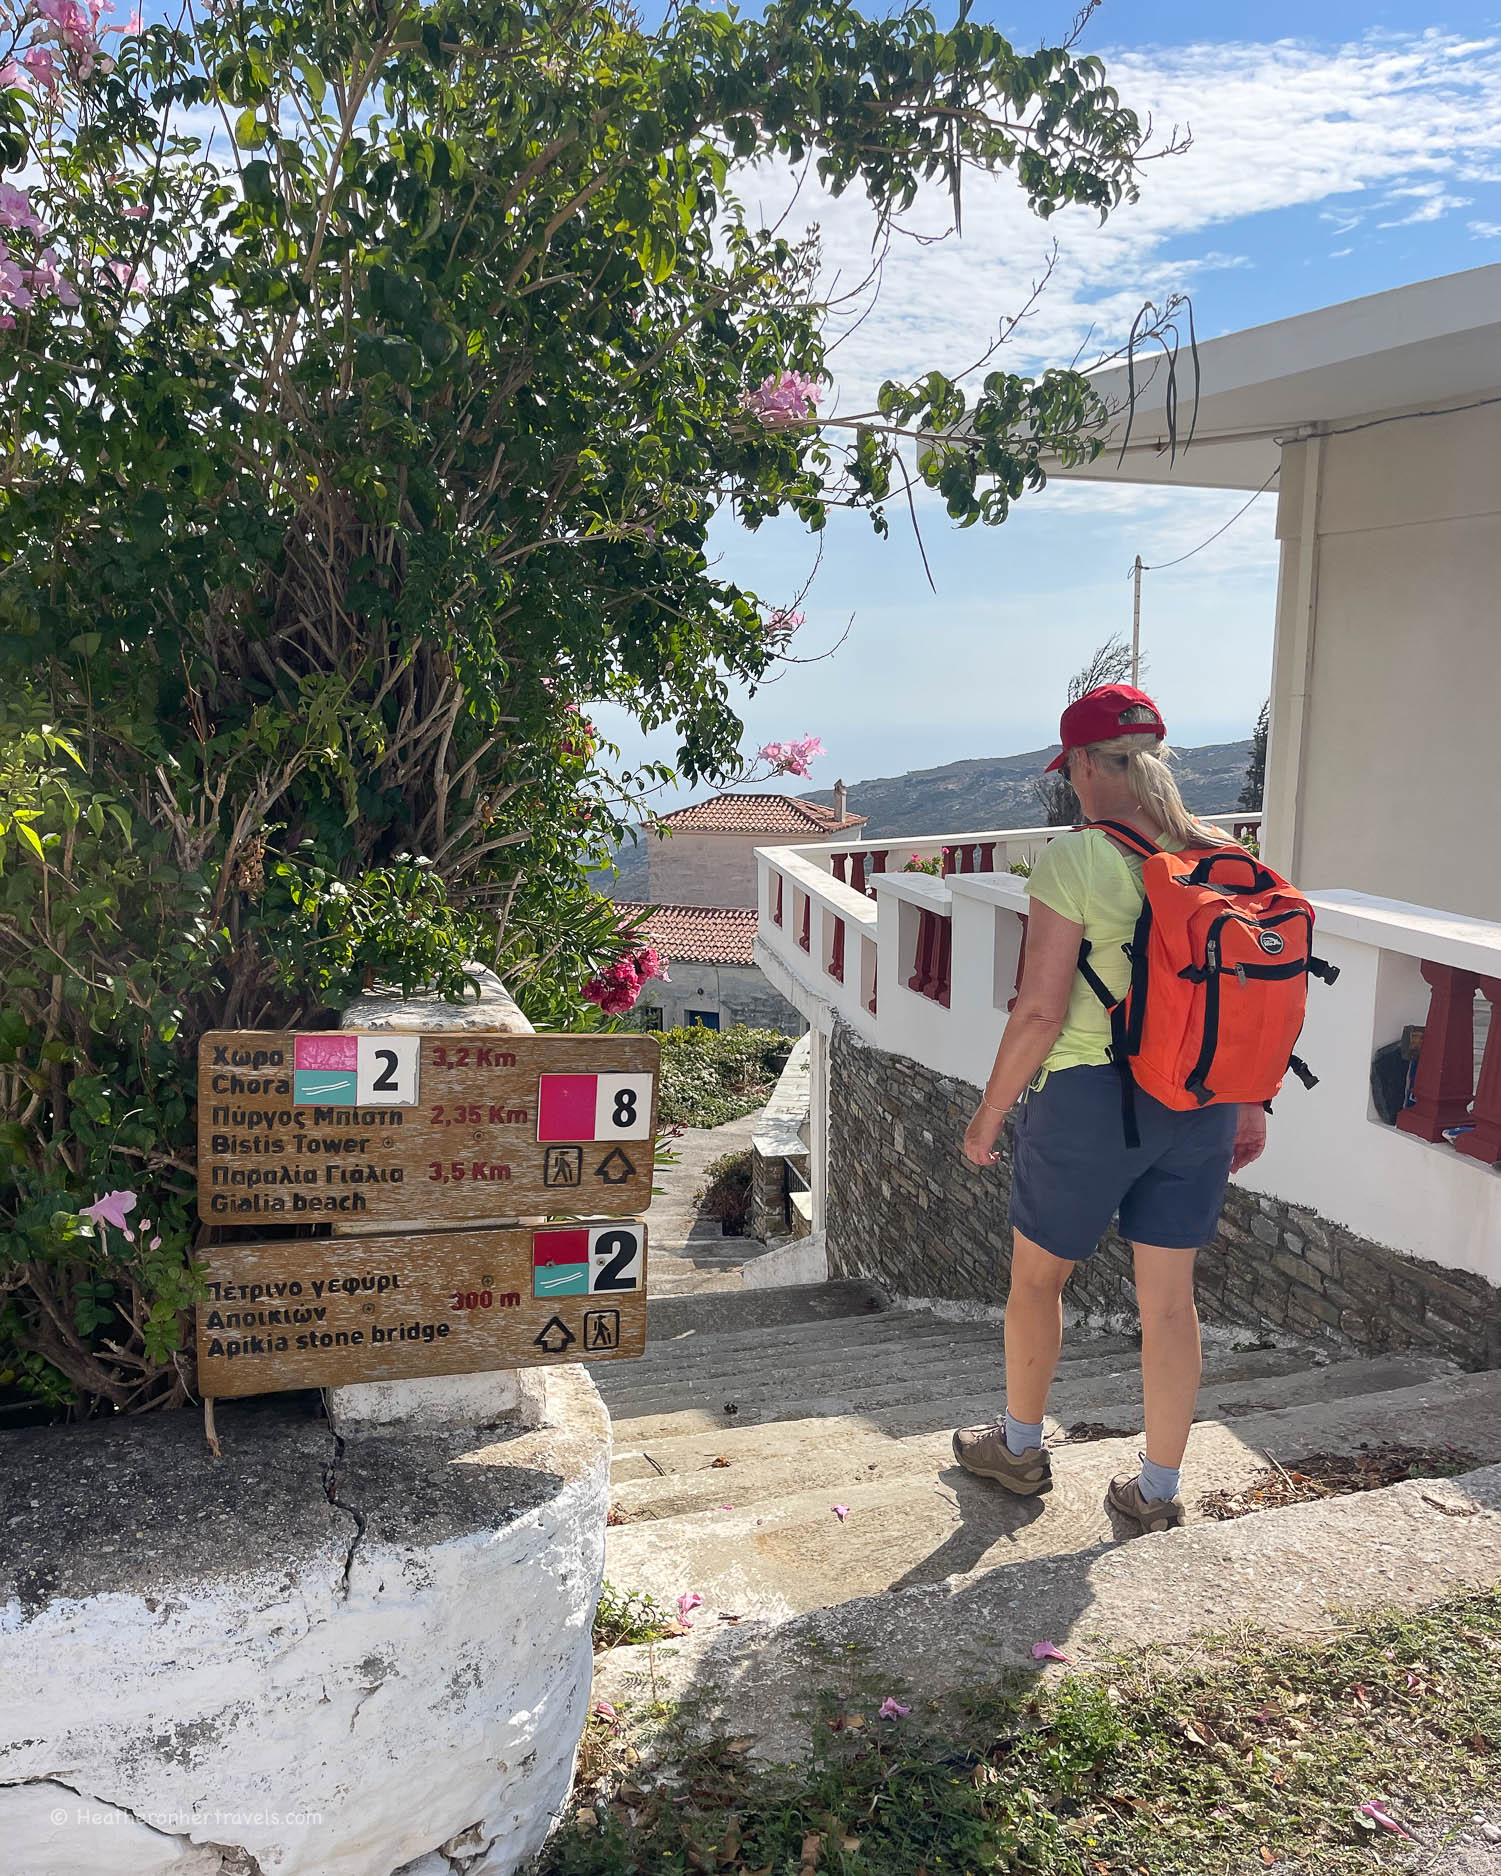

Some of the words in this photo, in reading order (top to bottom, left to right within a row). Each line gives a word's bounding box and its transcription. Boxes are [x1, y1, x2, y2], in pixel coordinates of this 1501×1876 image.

[373, 1049, 398, 1092] 2
[432, 1048, 470, 1070] 3,2
[477, 1048, 516, 1068] Km
[212, 1074, 290, 1095] Chora
[212, 1105, 306, 1130] Πύργος
[313, 1106, 403, 1126] Μπίστη
[430, 1105, 482, 1127] 2,35
[489, 1105, 528, 1125] Km
[612, 1088, 637, 1128] 8
[211, 1134, 286, 1154] Bistis
[293, 1134, 370, 1154] Tower
[212, 1164, 317, 1189] Παραλία
[428, 1161, 465, 1184] 3,5
[472, 1161, 511, 1181] Km
[211, 1193, 286, 1214] Gialia
[293, 1192, 367, 1212] beach
[594, 1230, 638, 1291] 2
[311, 1271, 403, 1300] γεφύρι
[450, 1290, 493, 1310] 300
[500, 1291, 521, 1307] m
[207, 1303, 327, 1330] Αποικιών
[207, 1332, 289, 1360] Apikia
[295, 1329, 364, 1351] stone
[371, 1321, 451, 1344] bridge
